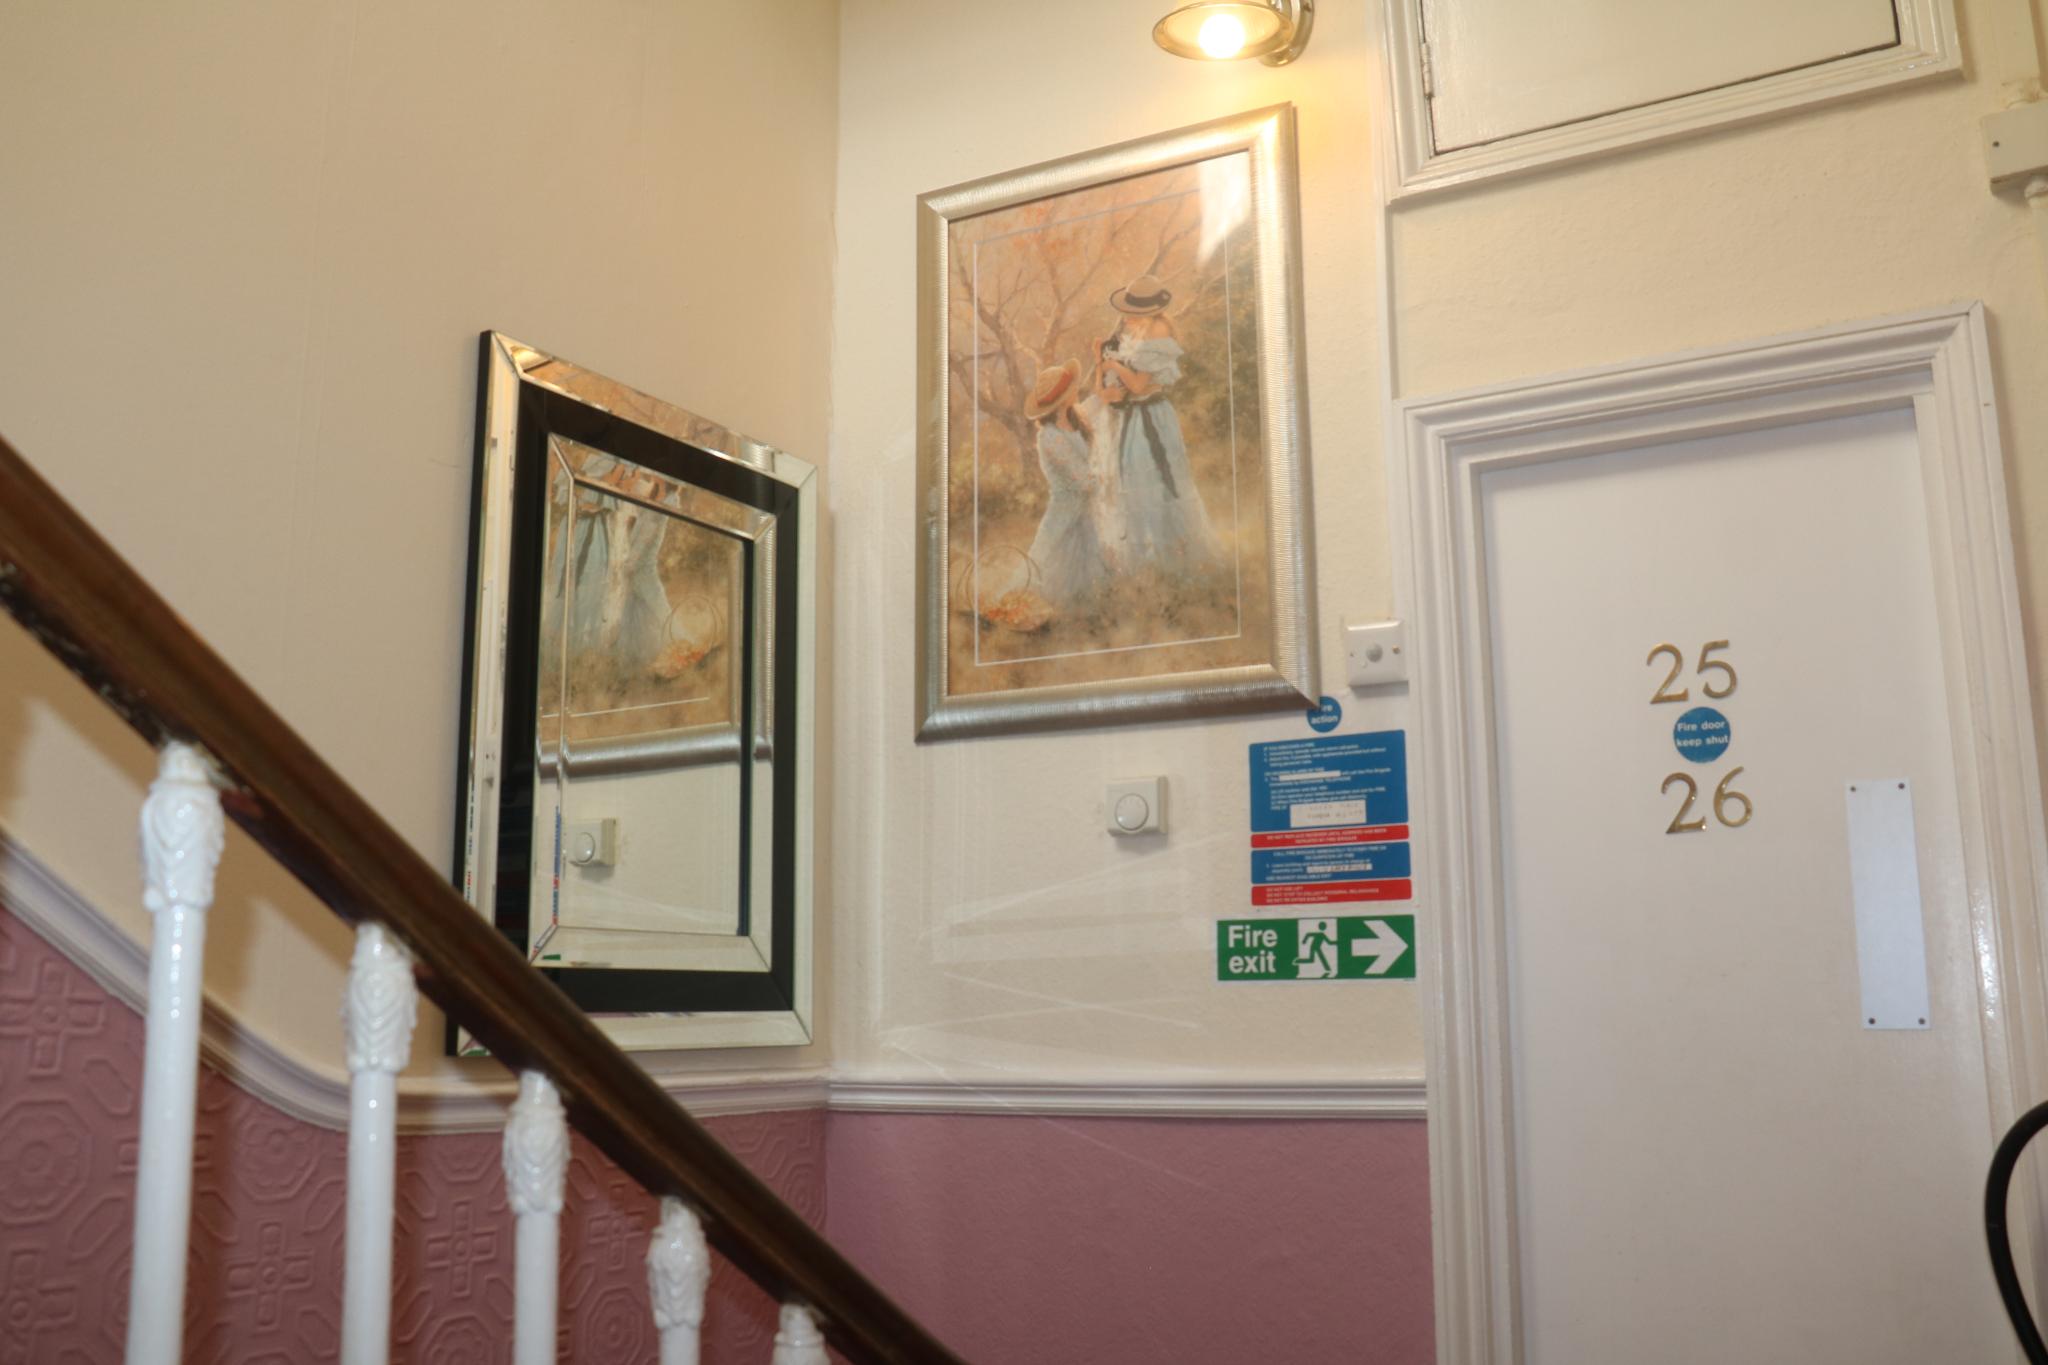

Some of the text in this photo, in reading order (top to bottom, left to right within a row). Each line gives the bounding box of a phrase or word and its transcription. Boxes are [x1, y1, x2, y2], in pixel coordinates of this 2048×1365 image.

[1647, 639, 1737, 704] 25
[1311, 715, 1338, 725] action
[1677, 720, 1726, 732] Fire door
[1675, 735, 1729, 748] keep shut
[1660, 766, 1753, 835] 26
[1228, 925, 1277, 948] Fire
[1229, 950, 1276, 973] exit
